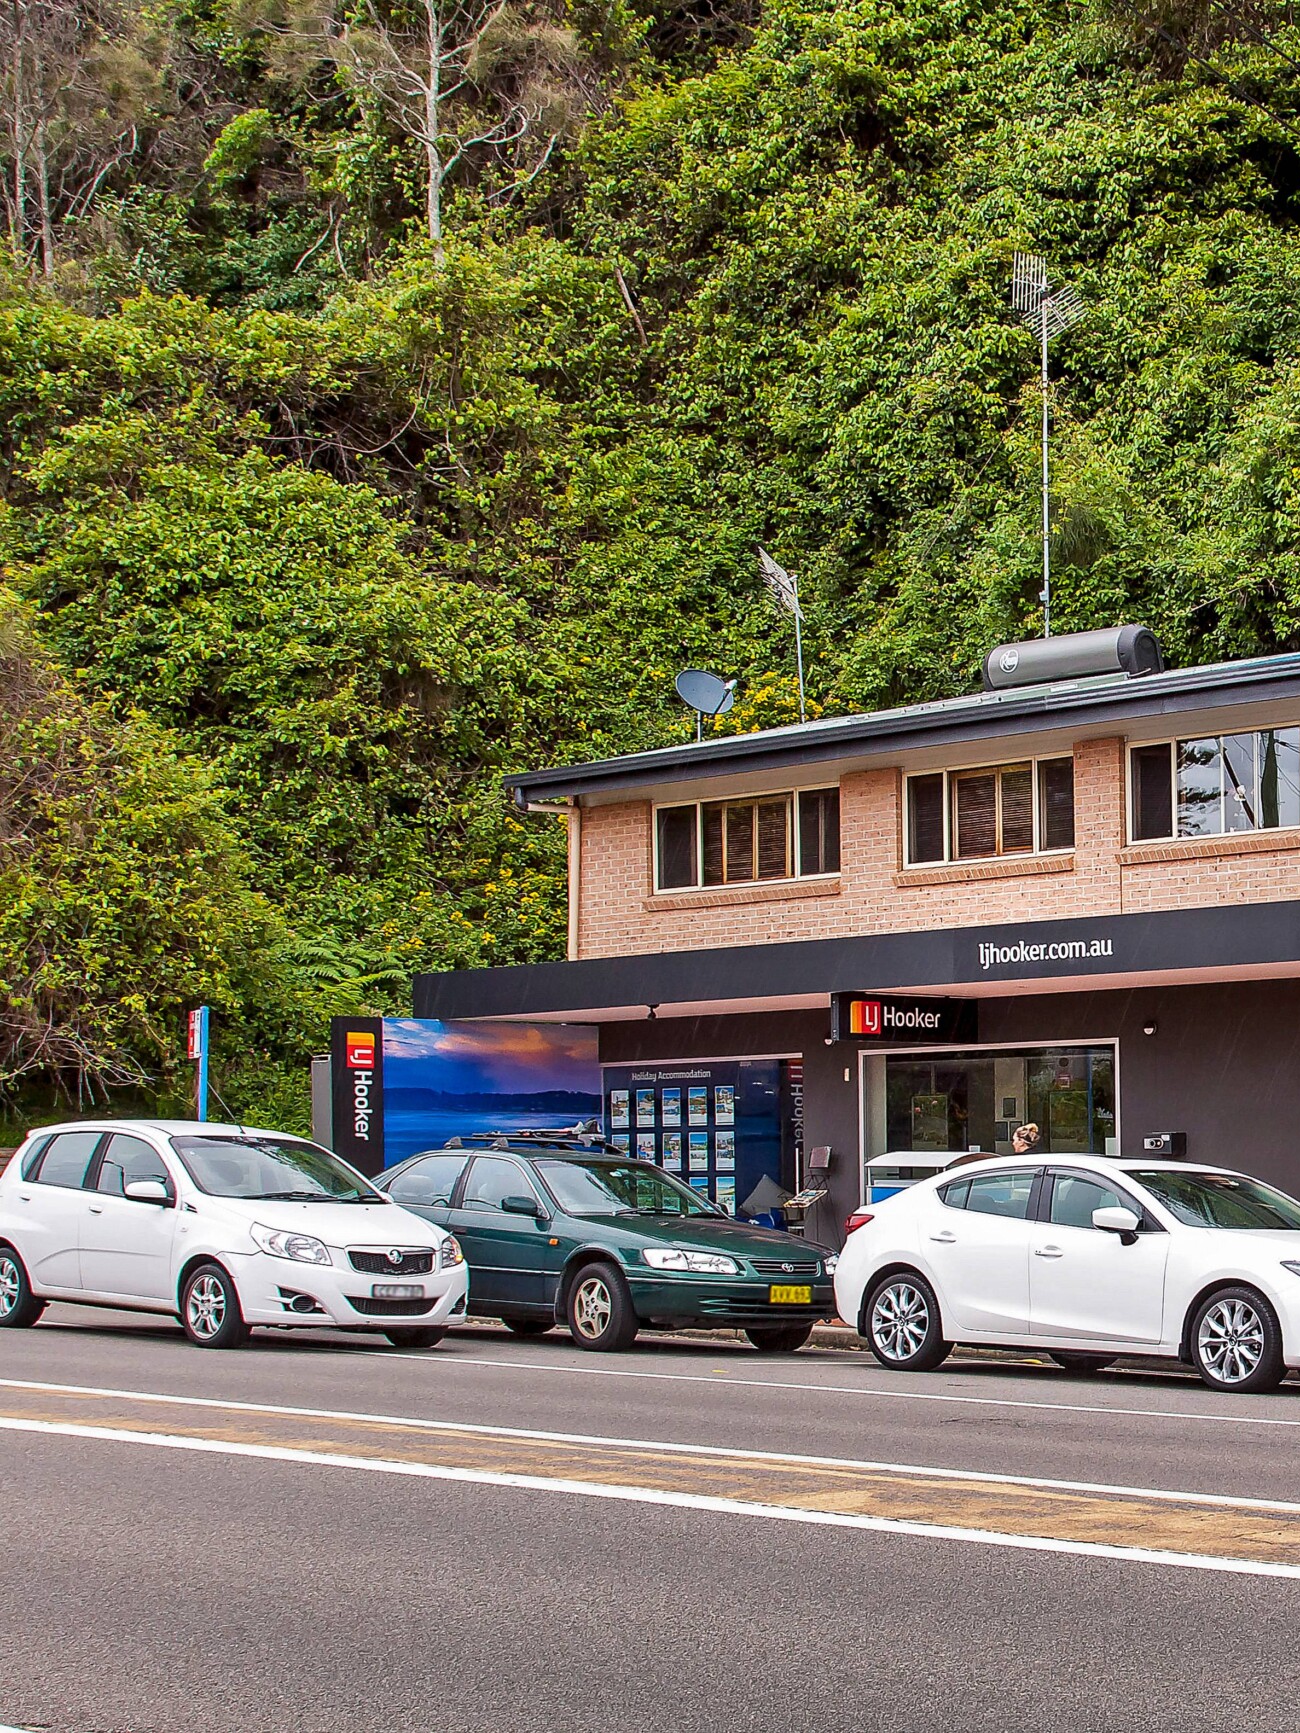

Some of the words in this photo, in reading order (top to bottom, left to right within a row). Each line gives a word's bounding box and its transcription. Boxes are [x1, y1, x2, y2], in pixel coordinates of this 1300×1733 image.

[978, 938, 1113, 970] ljhooker.com.au
[866, 1006, 878, 1031] LJ
[883, 1006, 941, 1028] Hooker
[350, 1049, 373, 1065] LJ
[631, 1071, 657, 1082] Holiday
[658, 1068, 712, 1080] Accommodation
[354, 1071, 373, 1141] Hooker
